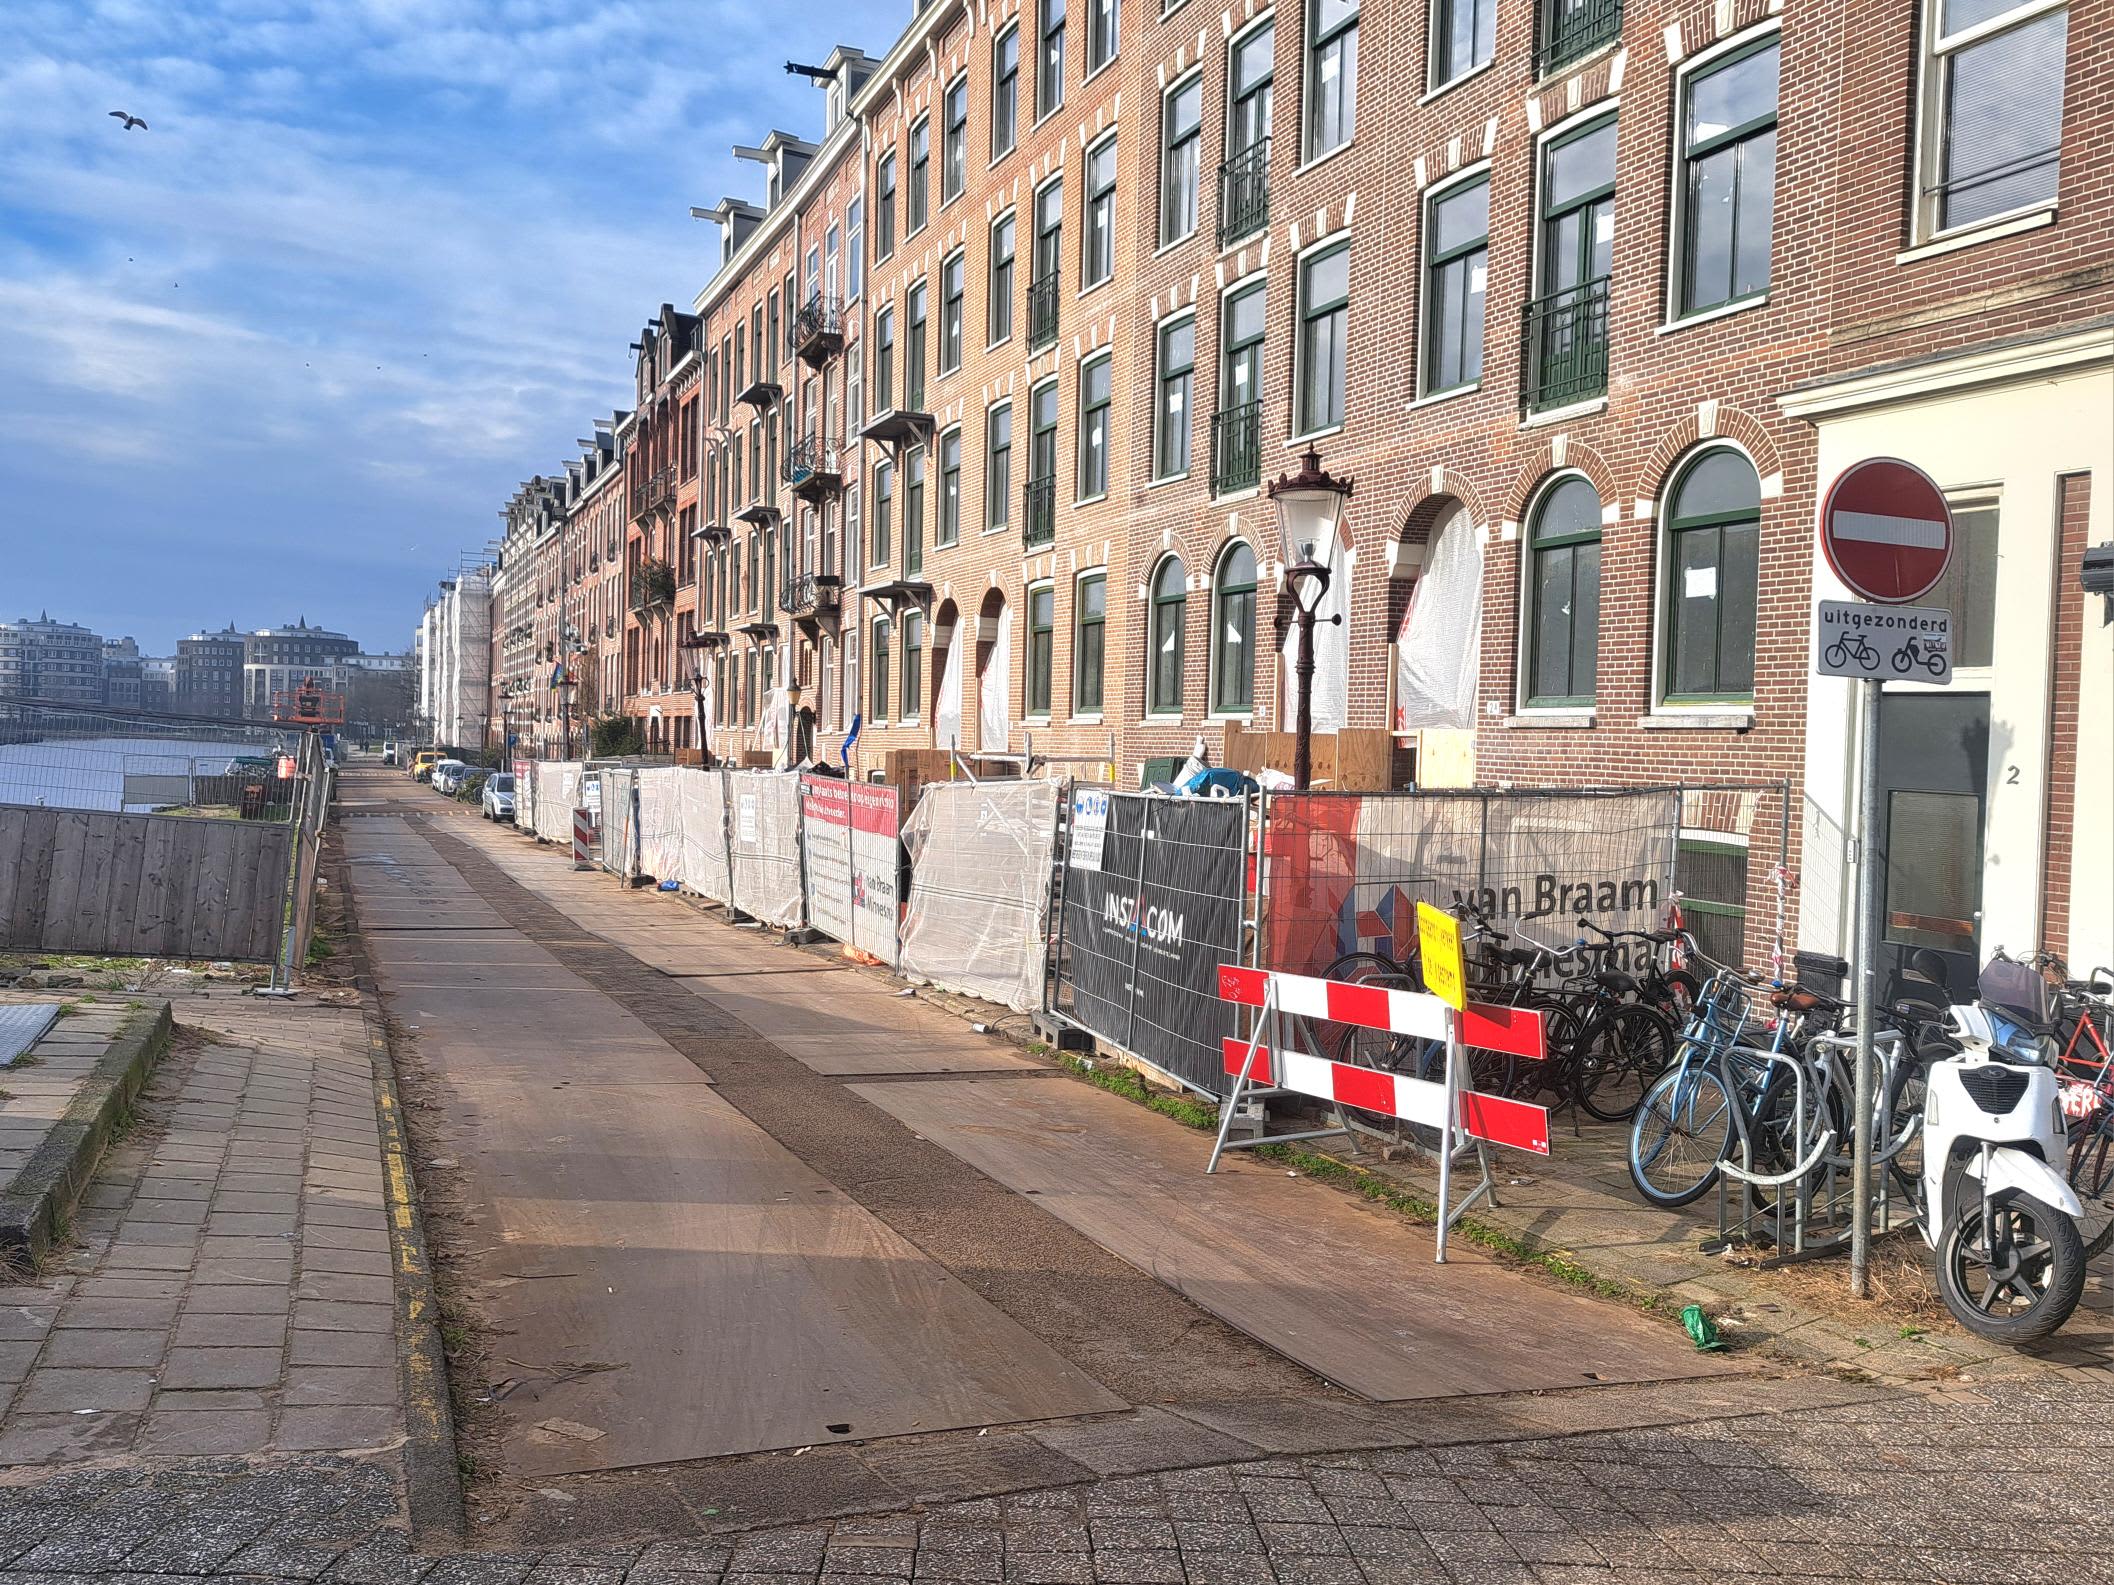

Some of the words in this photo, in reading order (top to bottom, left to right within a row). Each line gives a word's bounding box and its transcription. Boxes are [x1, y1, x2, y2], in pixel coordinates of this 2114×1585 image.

[1824, 609, 1948, 634] uitgezonderd
[2006, 764, 2021, 785] 2
[1452, 886, 1522, 922] van
[1535, 874, 1658, 915] Braam
